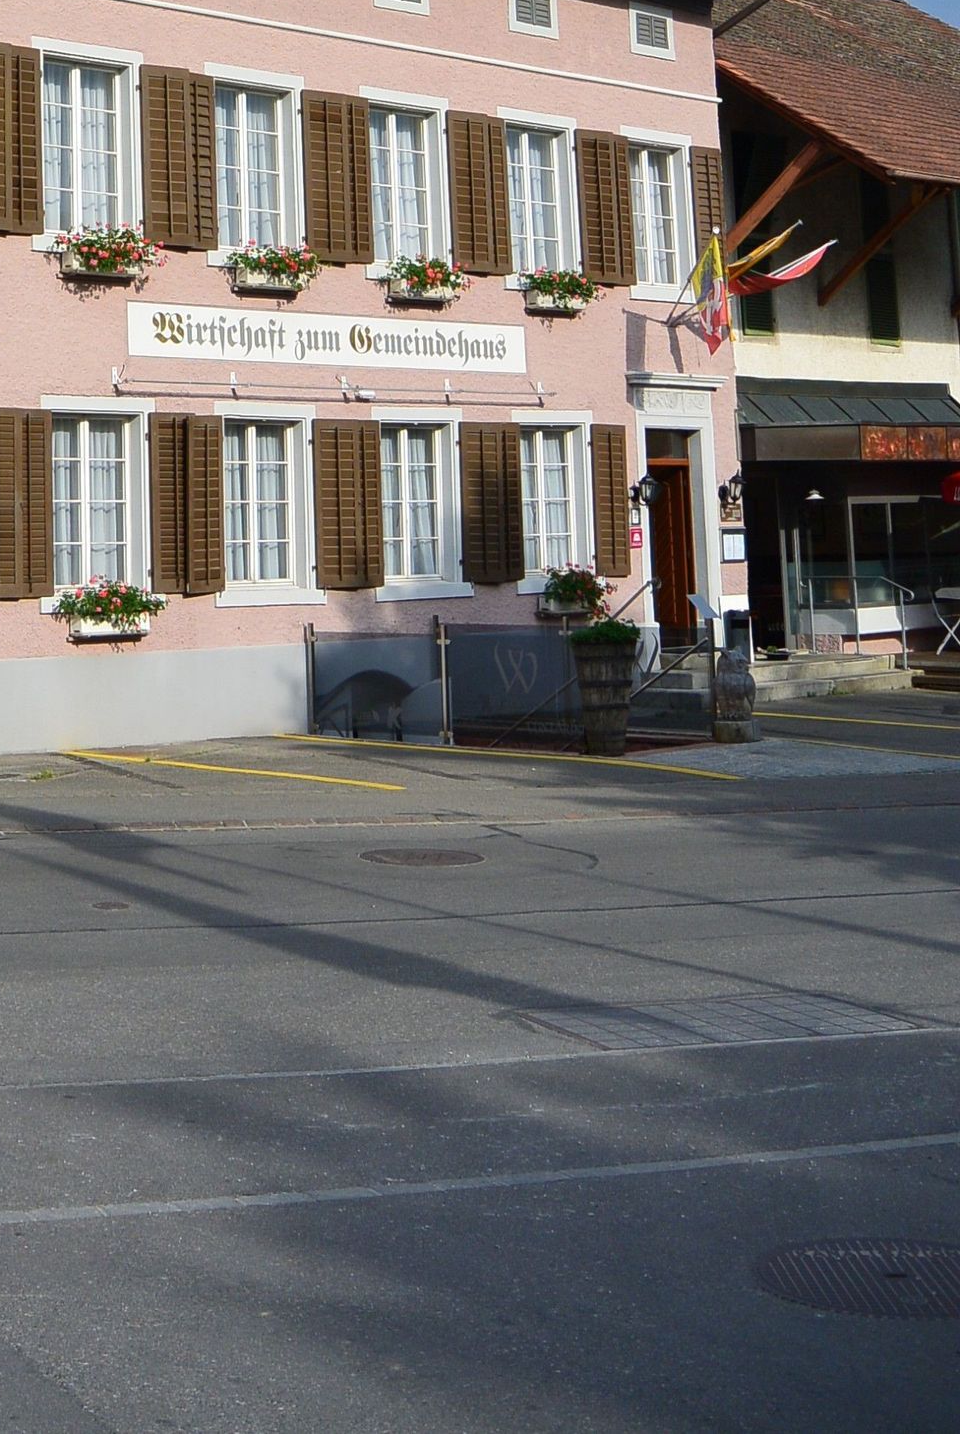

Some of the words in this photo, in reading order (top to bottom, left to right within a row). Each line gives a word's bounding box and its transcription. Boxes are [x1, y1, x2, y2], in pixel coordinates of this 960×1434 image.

[152, 311, 286, 359] Wirtschaft
[294, 327, 341, 361] zum
[349, 323, 507, 367] Gemeindehaus
